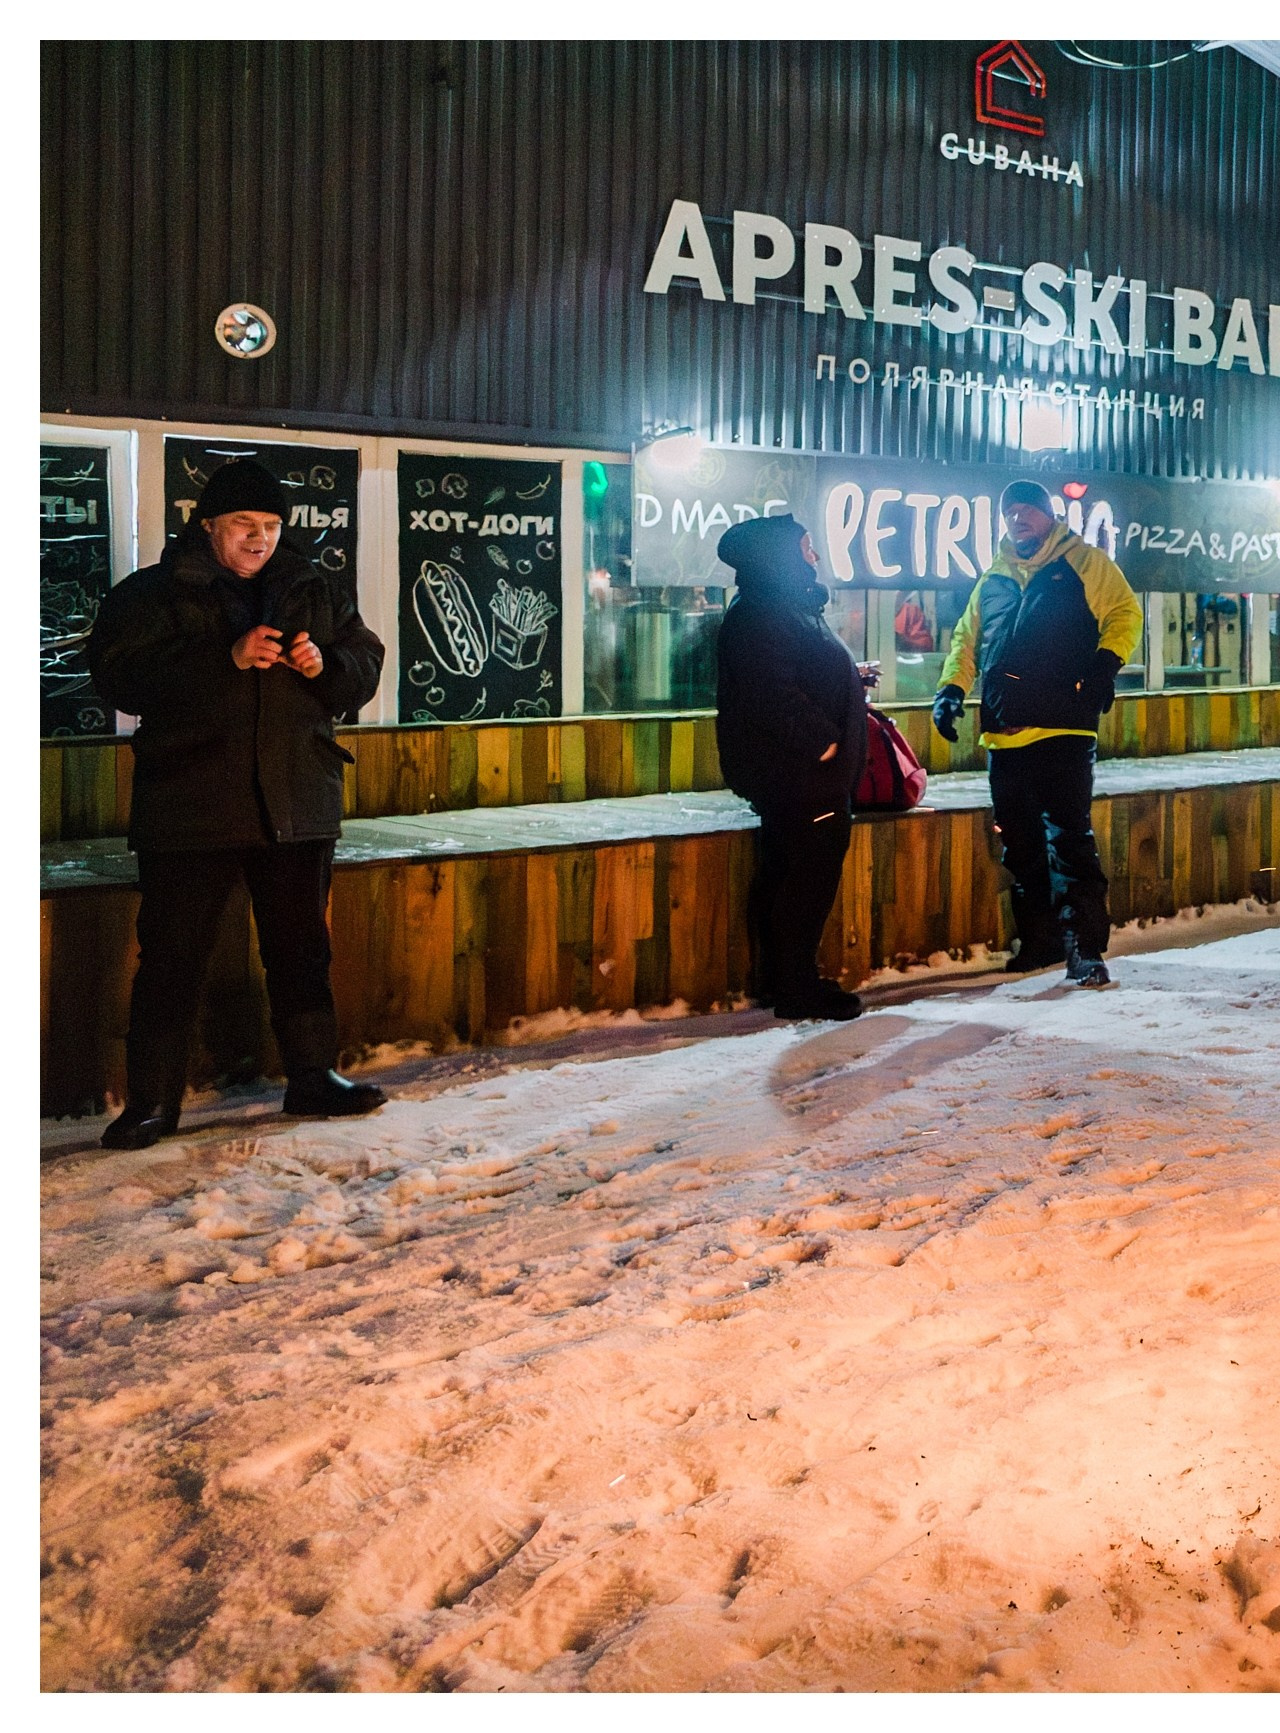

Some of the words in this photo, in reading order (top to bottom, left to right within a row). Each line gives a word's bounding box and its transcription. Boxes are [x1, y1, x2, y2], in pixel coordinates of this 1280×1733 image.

[940, 132, 1084, 187] GUBAHA
[643, 198, 1146, 358] APRES-SKI
[815, 353, 1034, 402] ПОЛЯРНАЯ
[1048, 381, 1205, 420] СТАНЦИЯ
[409, 509, 554, 536] ХОТ-ДОГИ
